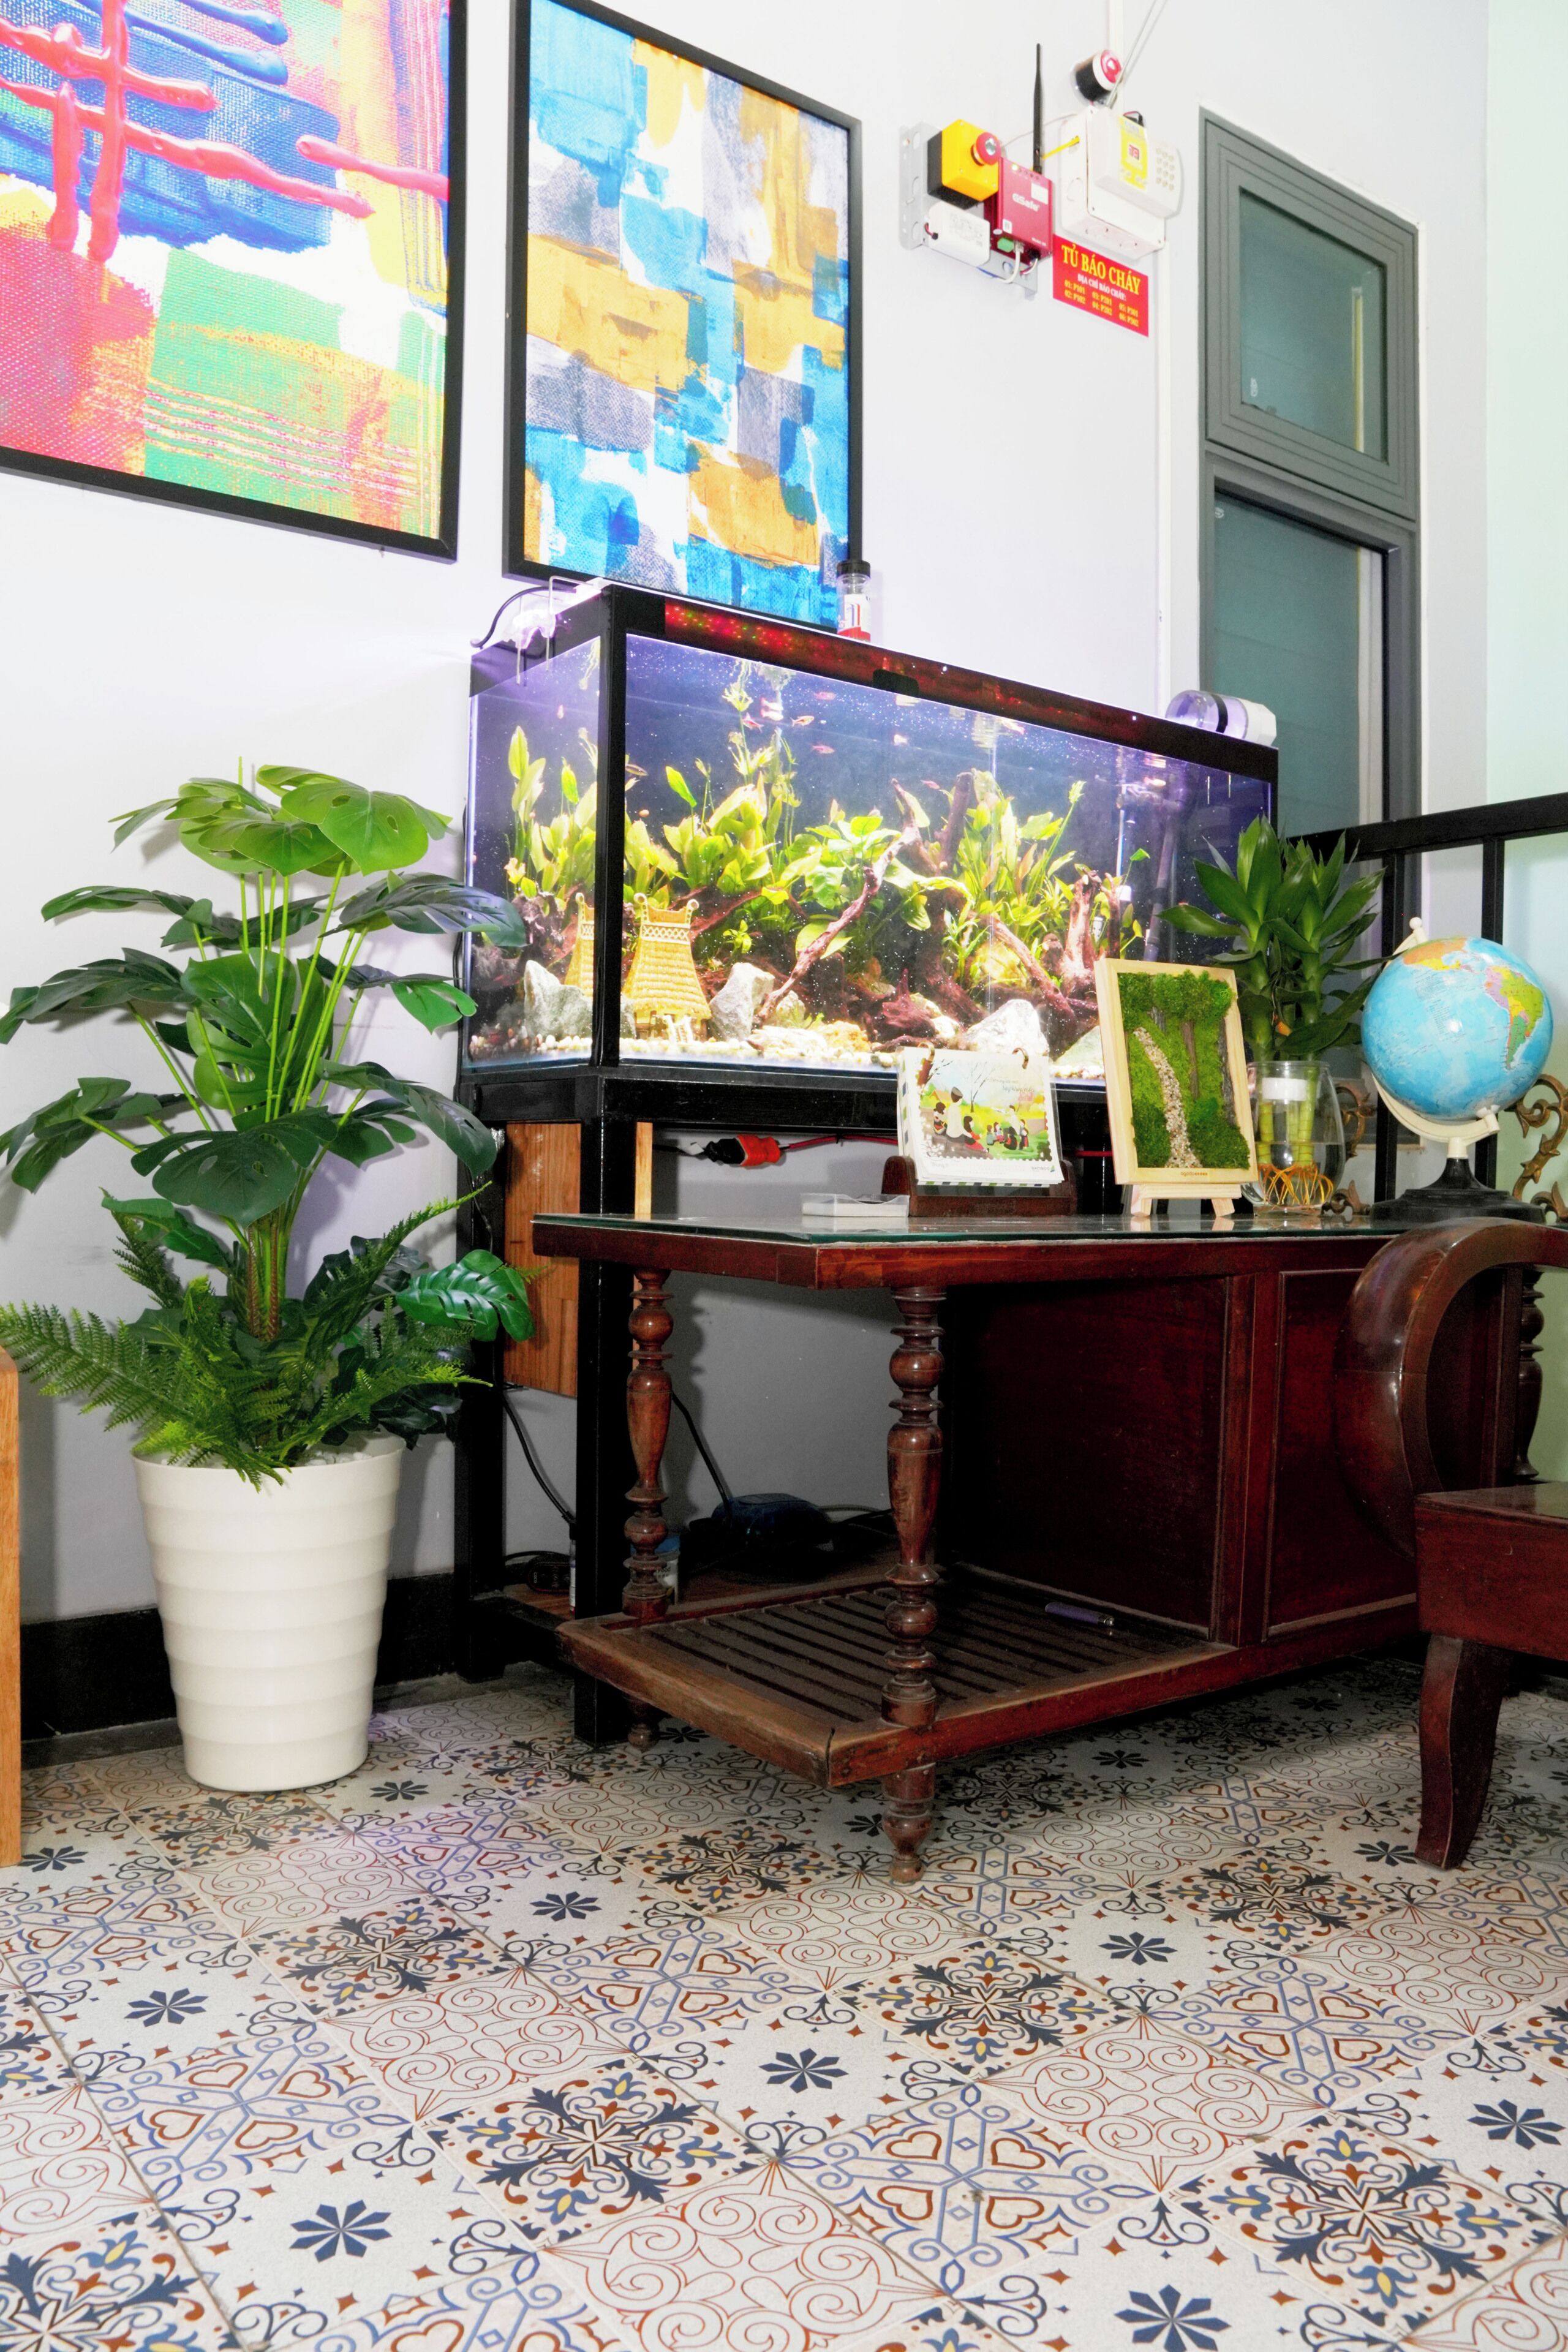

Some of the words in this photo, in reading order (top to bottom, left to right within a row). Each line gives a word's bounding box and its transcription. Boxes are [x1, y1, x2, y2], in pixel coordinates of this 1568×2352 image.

[1061, 244, 1078, 267] TỦ
[1081, 254, 1106, 279] BÁO
[1109, 266, 1140, 295] CHÁY
